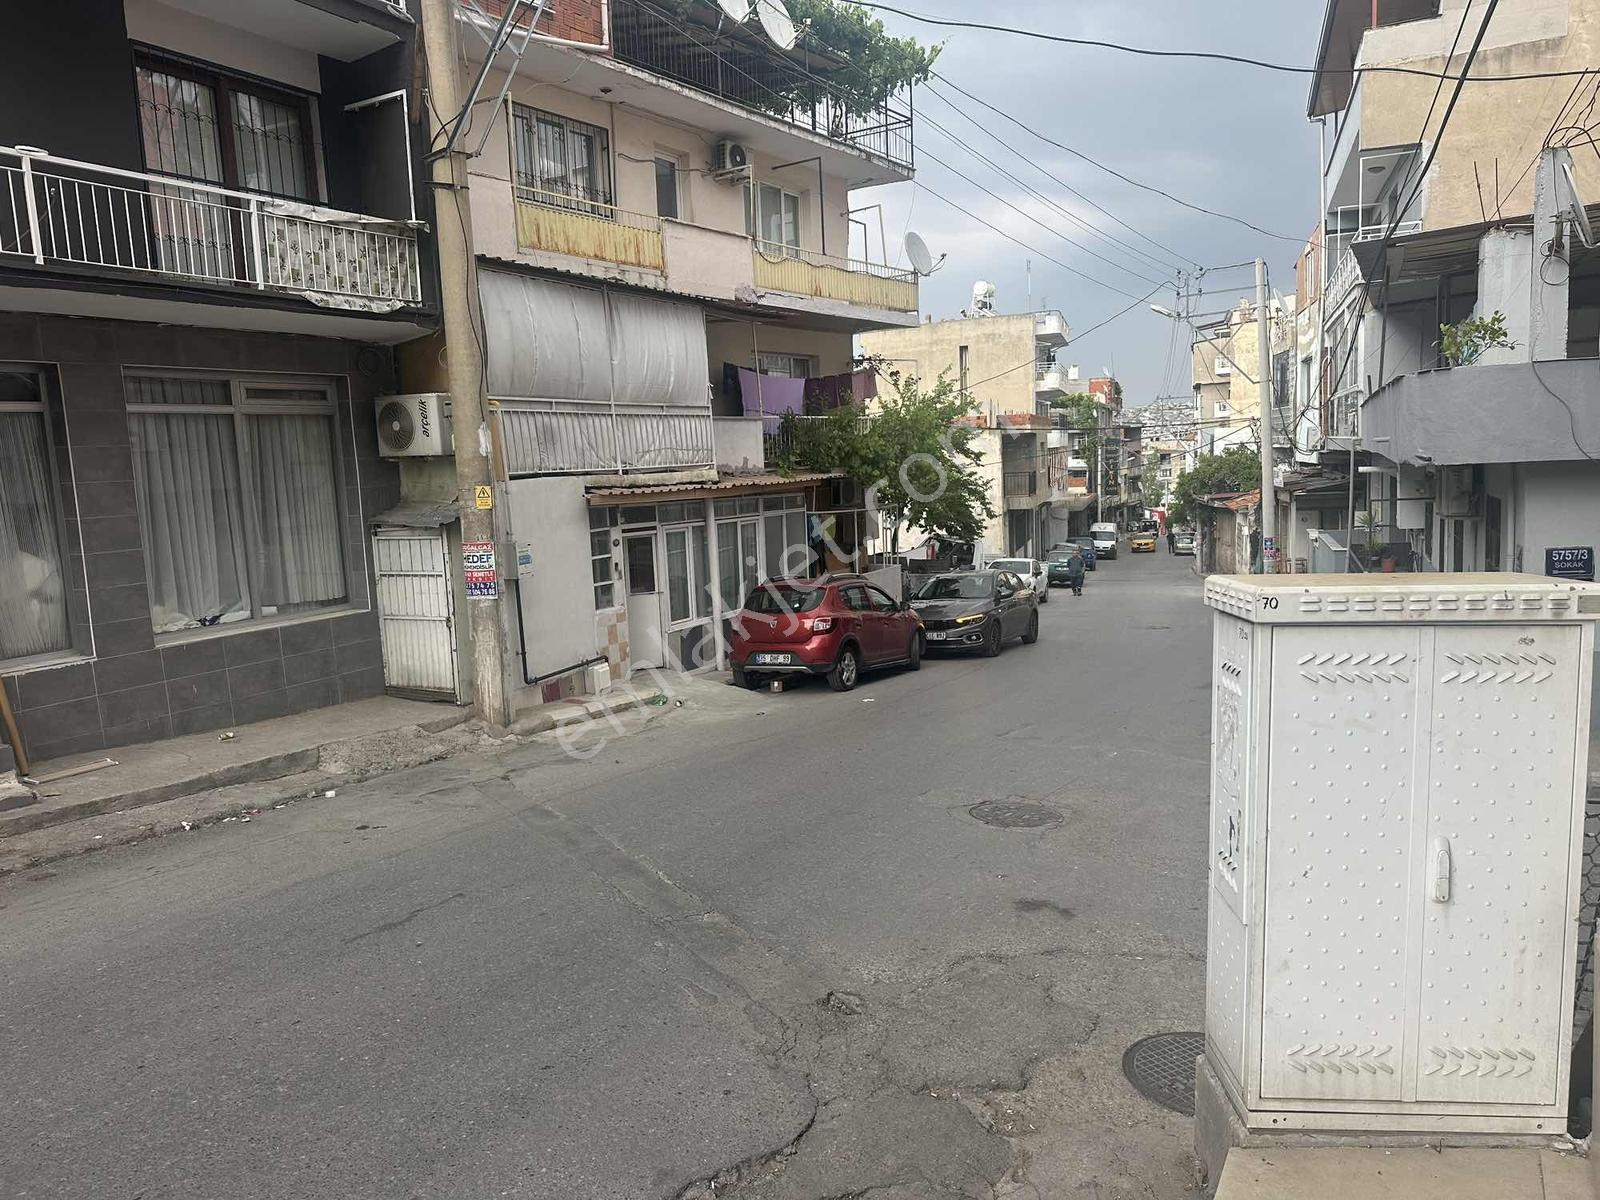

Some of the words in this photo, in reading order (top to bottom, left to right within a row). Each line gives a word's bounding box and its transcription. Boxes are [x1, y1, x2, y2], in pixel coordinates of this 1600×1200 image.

[418, 398, 431, 437] arçelik
[1552, 549, 1588, 560] 5757/3
[1554, 561, 1584, 569] SOKAK
[1261, 596, 1279, 610] 70
